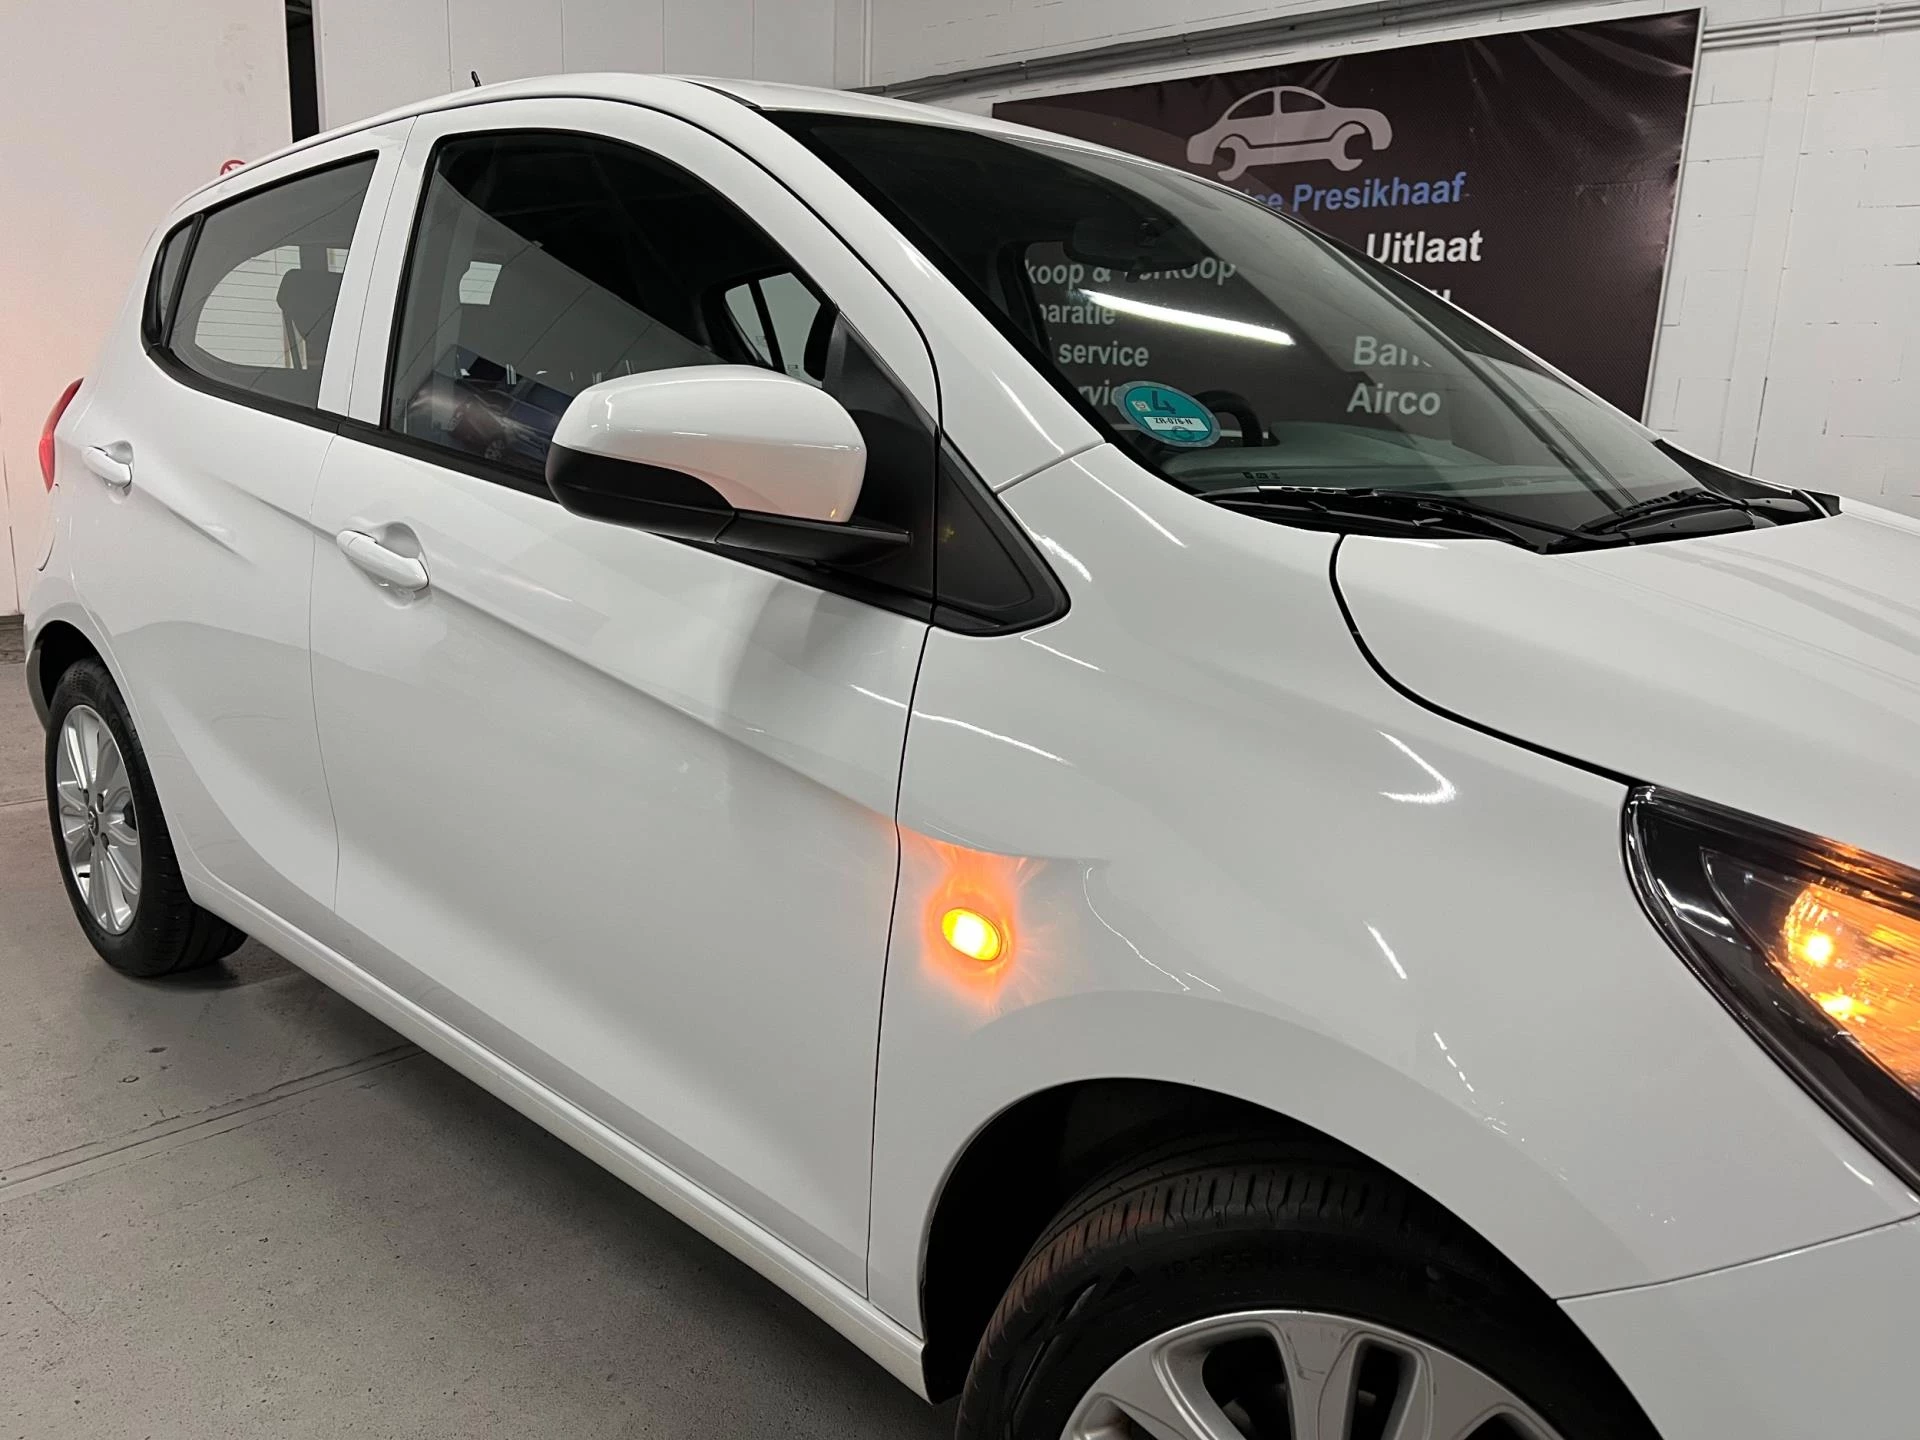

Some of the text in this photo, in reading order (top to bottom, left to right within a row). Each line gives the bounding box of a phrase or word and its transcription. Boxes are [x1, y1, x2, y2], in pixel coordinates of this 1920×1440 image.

[1292, 171, 1467, 213] Presikhaaf
[1366, 229, 1483, 264] Uitlaat
[1058, 340, 1150, 367] service
[1346, 382, 1441, 416] Airco
